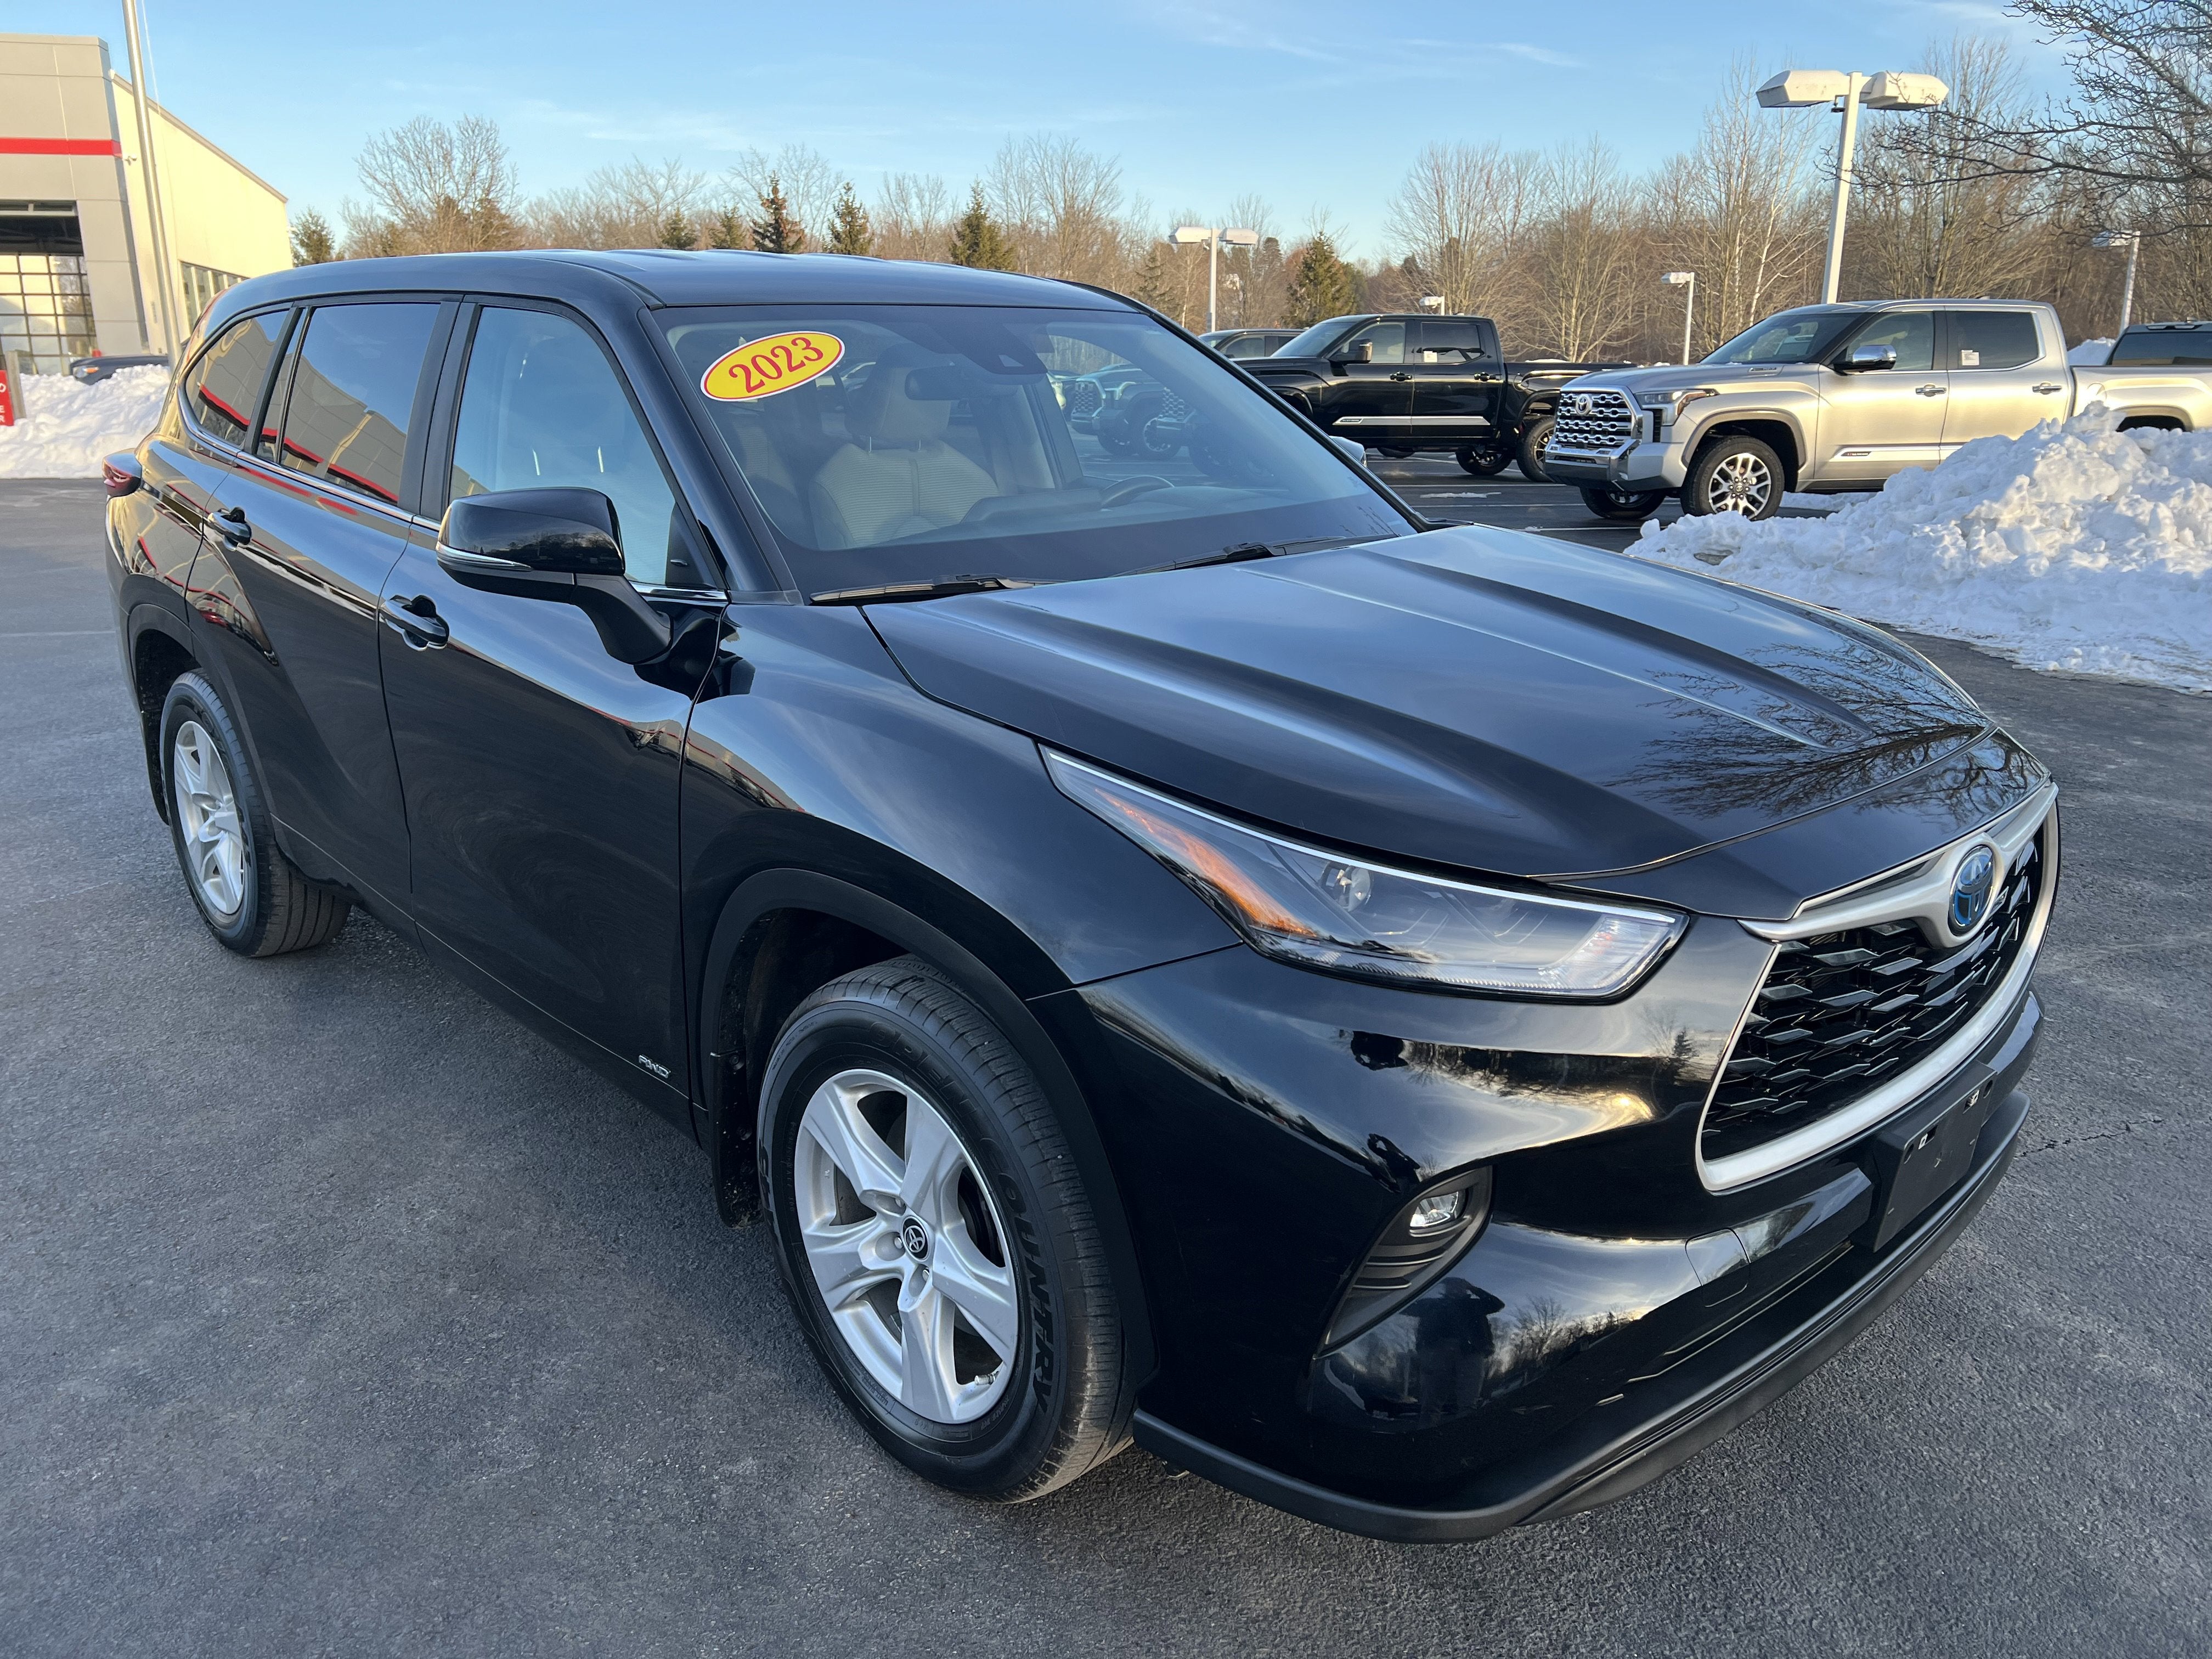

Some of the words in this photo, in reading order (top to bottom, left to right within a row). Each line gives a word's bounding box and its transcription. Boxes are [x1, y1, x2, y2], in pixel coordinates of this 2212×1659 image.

[729, 337, 823, 393] 2023
[638, 1054, 669, 1079] AWD
[869, 1022, 977, 1118] OPEN
[979, 1137, 1054, 1414] COUNTRY
